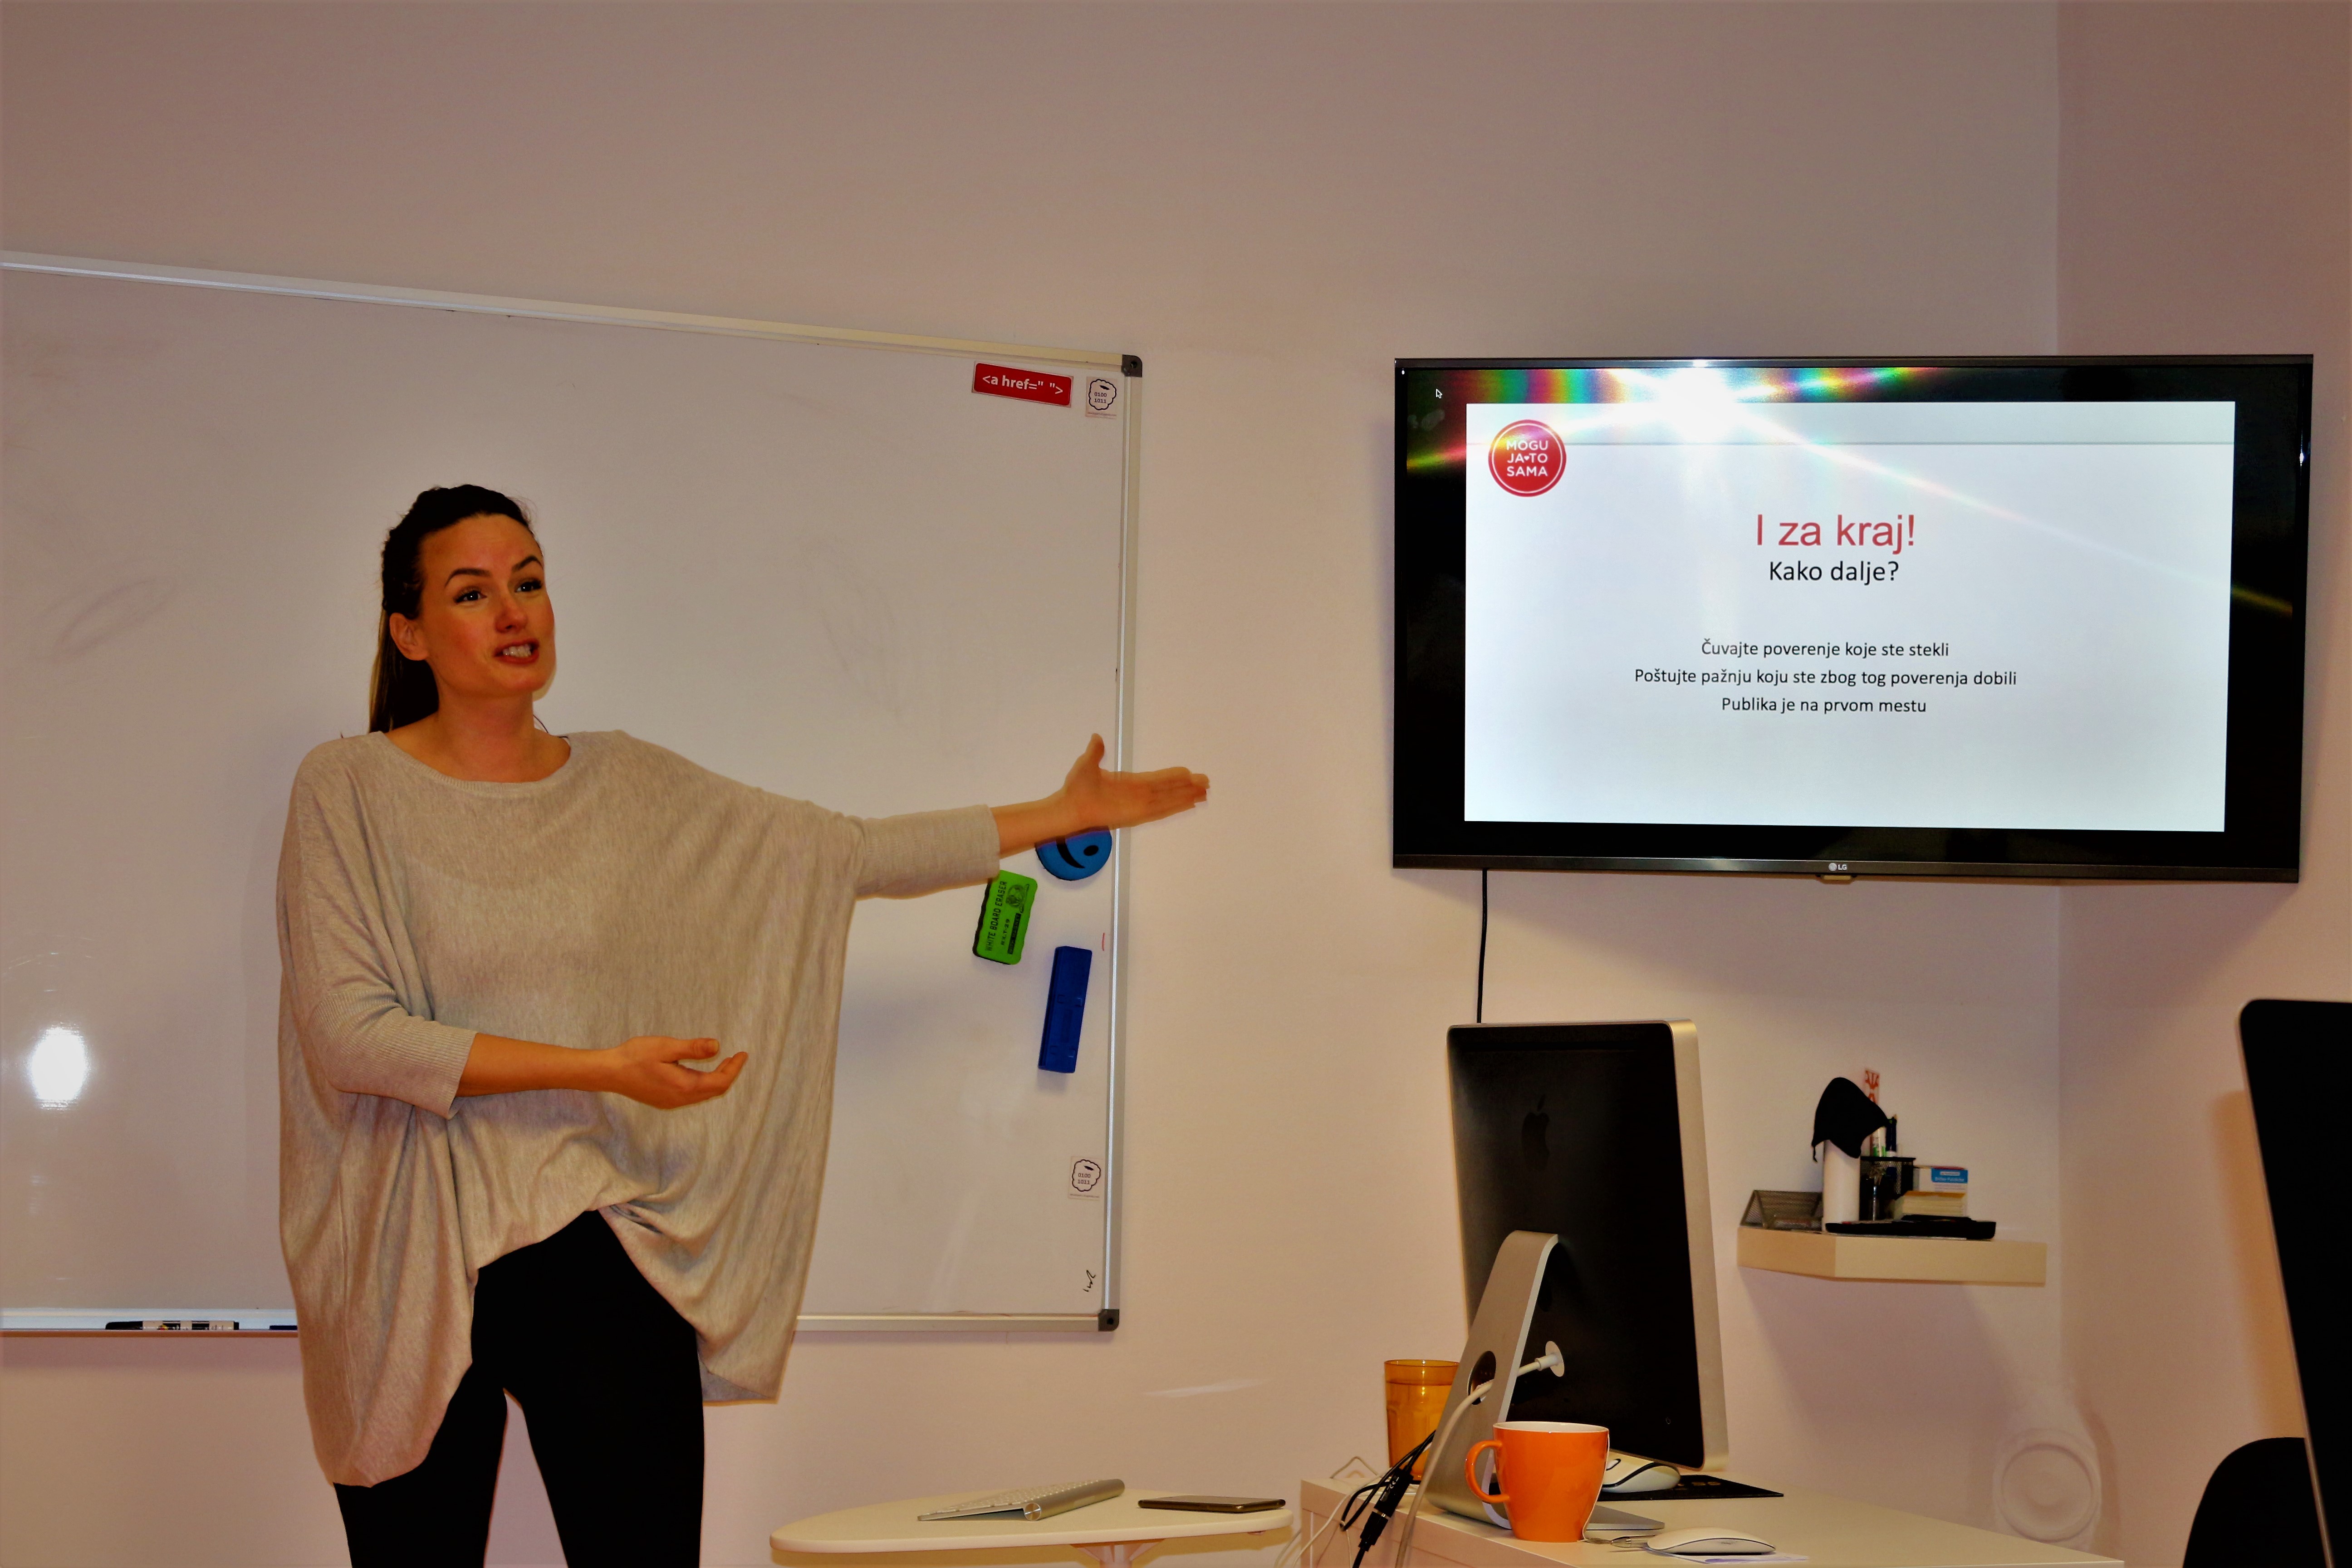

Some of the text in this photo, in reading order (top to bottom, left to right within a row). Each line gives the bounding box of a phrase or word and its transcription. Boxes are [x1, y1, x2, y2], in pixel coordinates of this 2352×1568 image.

[982, 375, 998, 385] <a
[1506, 440, 1548, 451] MOGU
[1507, 466, 1548, 476] SAMA
[1758, 514, 1914, 554] I za kraj!
[1770, 560, 1899, 586] Kako dalje?
[1701, 638, 1949, 659] Čuvajte poverenje koje ste stekli
[1635, 668, 2016, 688] Poštujte pažnju koju ste zbog tog poverenja dobili
[1722, 697, 1926, 715] Publika je na prvom mestu
[985, 881, 1007, 951] WHITE BOARD ERASER
